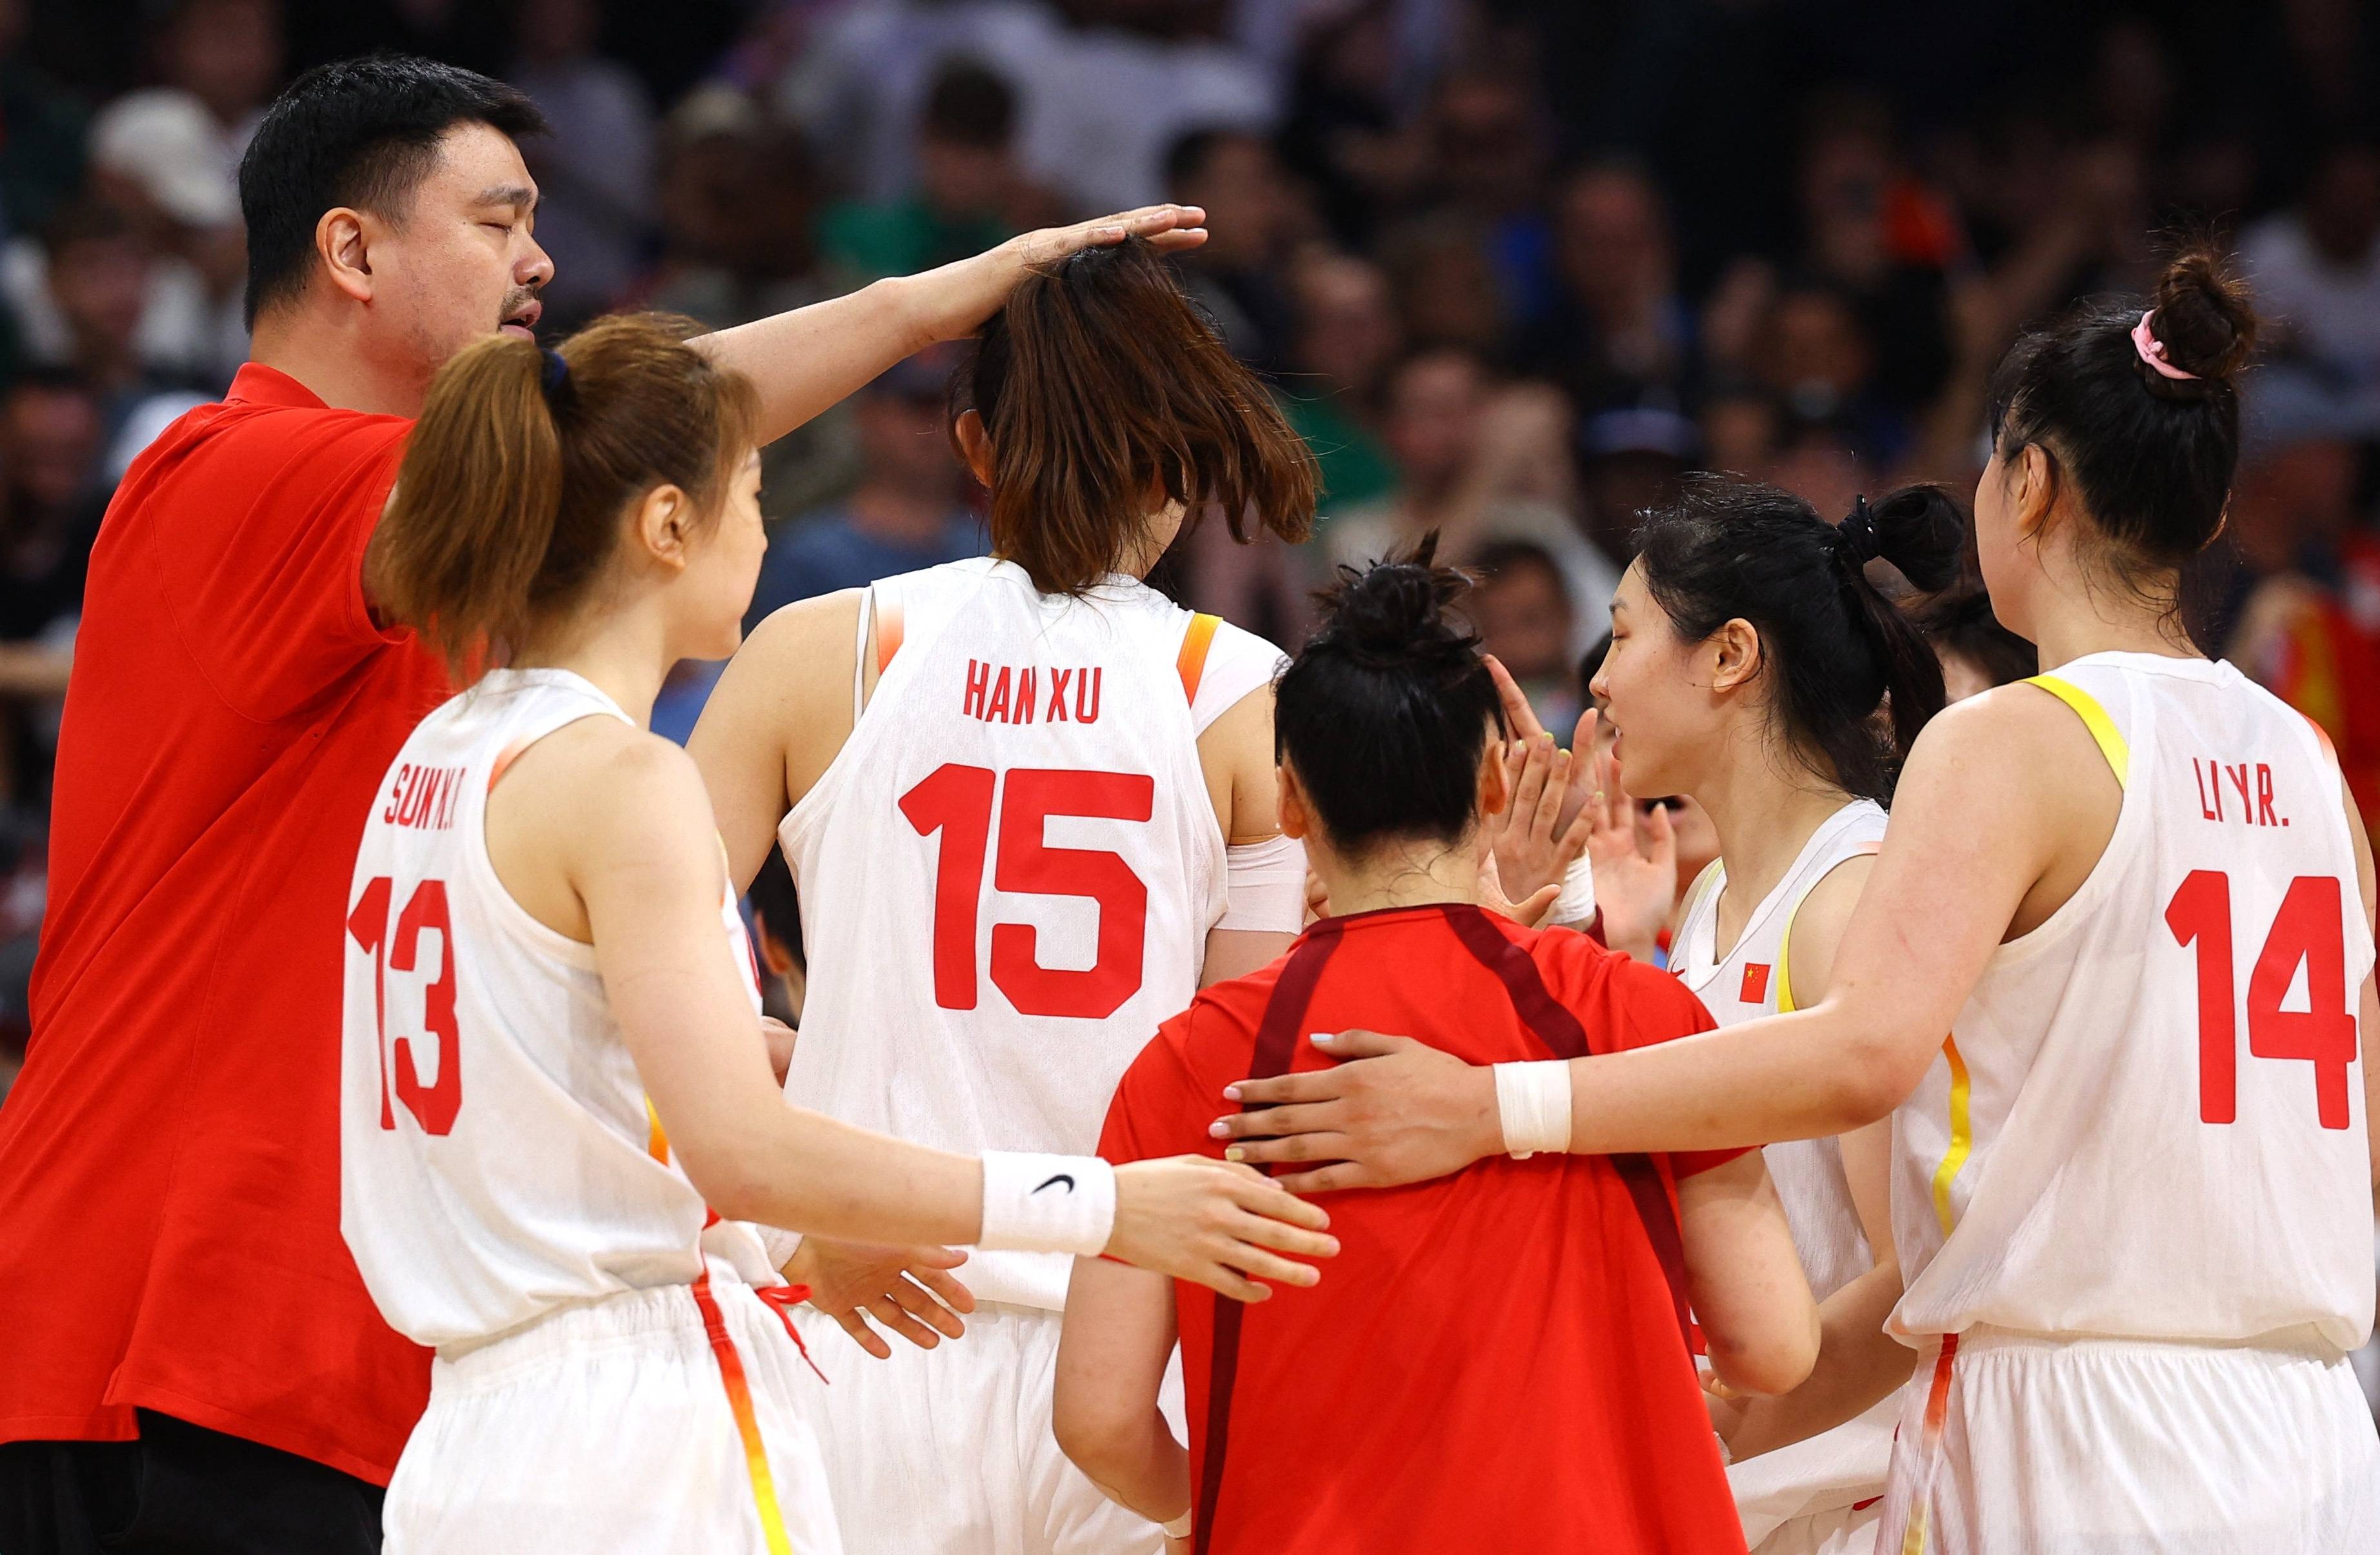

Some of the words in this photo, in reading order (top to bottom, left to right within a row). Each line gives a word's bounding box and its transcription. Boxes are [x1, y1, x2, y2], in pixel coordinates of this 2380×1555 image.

[963, 659, 1037, 725] HAN
[1046, 666, 1103, 724] XU
[384, 763, 443, 830] SUN
[2193, 757, 2224, 823] LI
[897, 762, 1155, 1020] 15
[347, 877, 463, 1136] 13
[2165, 869, 2357, 1131] 14
